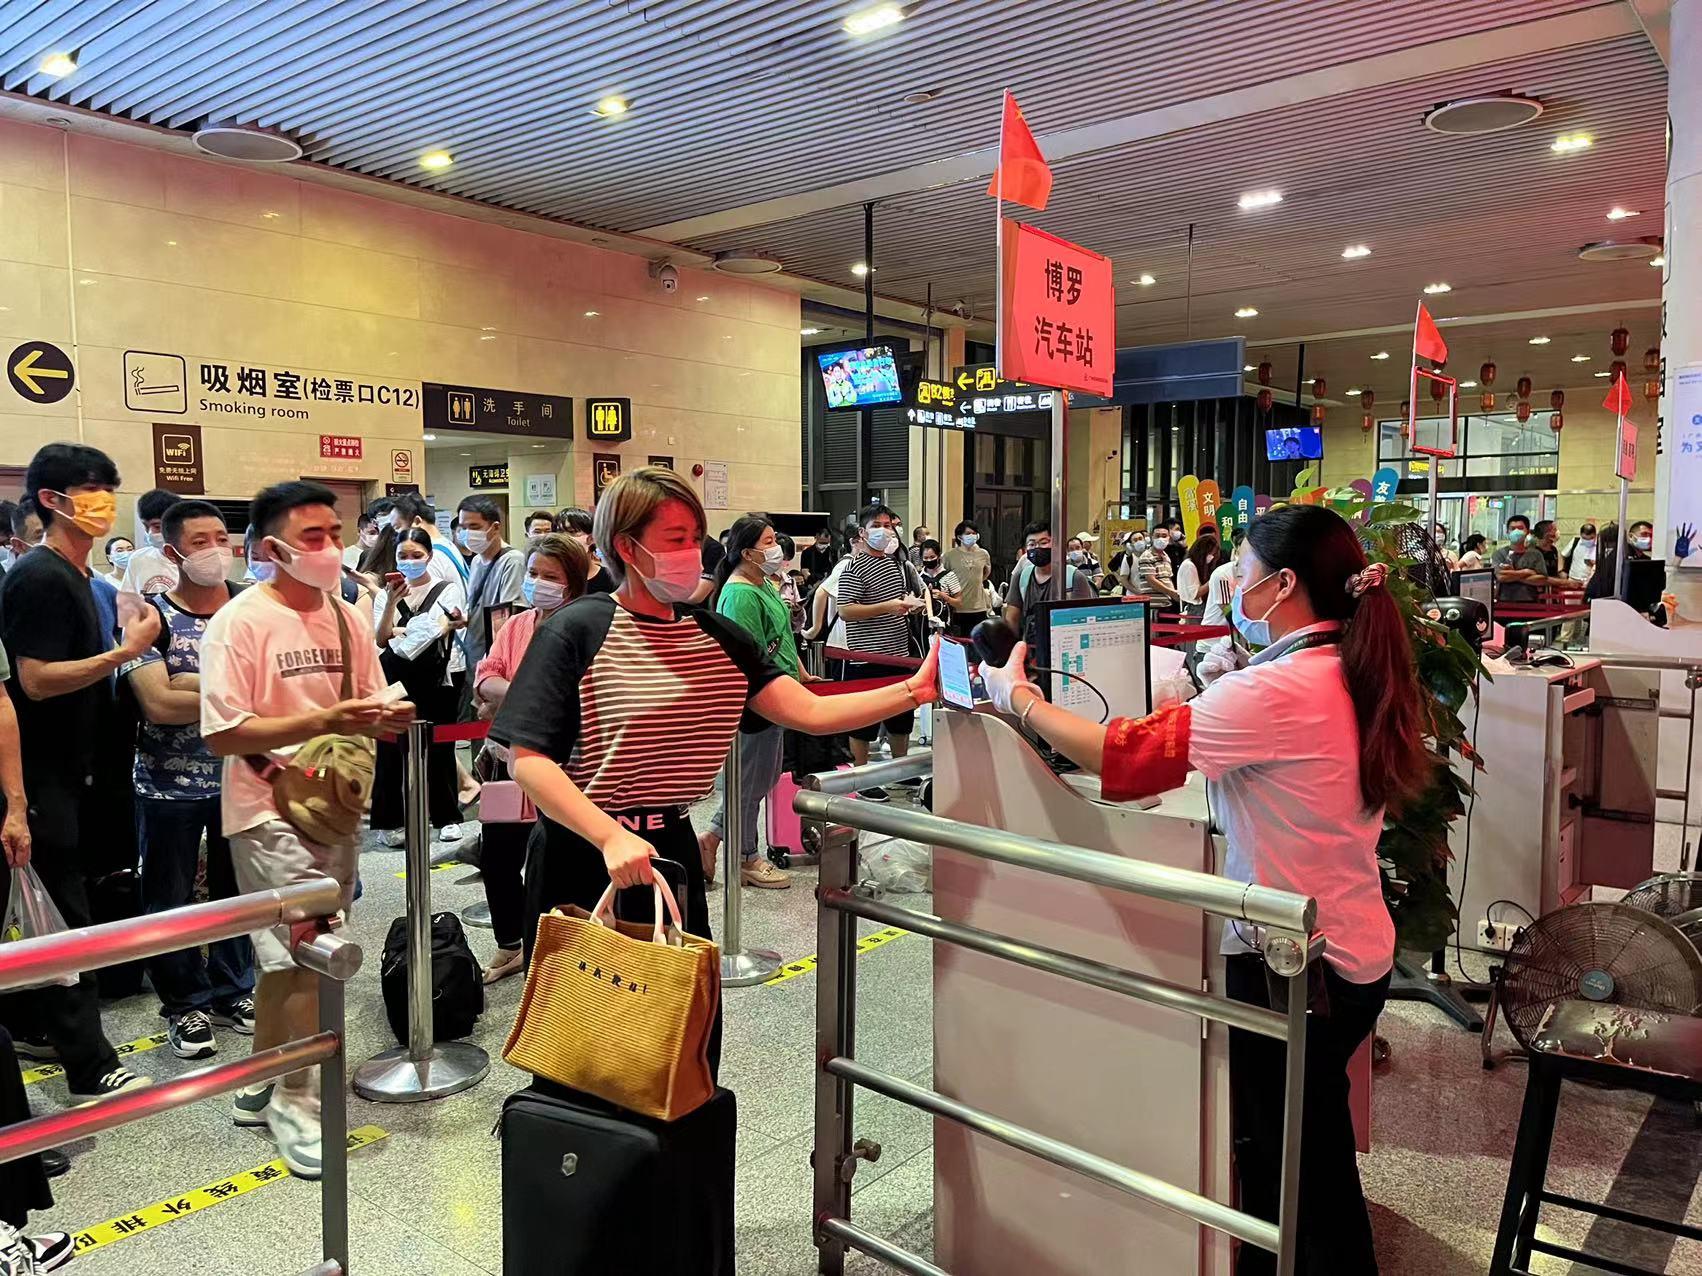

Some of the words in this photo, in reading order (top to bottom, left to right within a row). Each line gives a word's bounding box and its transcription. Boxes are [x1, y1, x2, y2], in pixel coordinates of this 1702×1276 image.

[1044, 258, 1084, 306] 博罗
[1034, 315, 1094, 368] 汽车站
[199, 398, 265, 419] Smoking
[271, 404, 310, 420] room
[483, 397, 553, 419] 洗手间
[506, 415, 531, 428] Toilet
[1202, 491, 1216, 517] 文明
[1237, 498, 1249, 524] 自由
